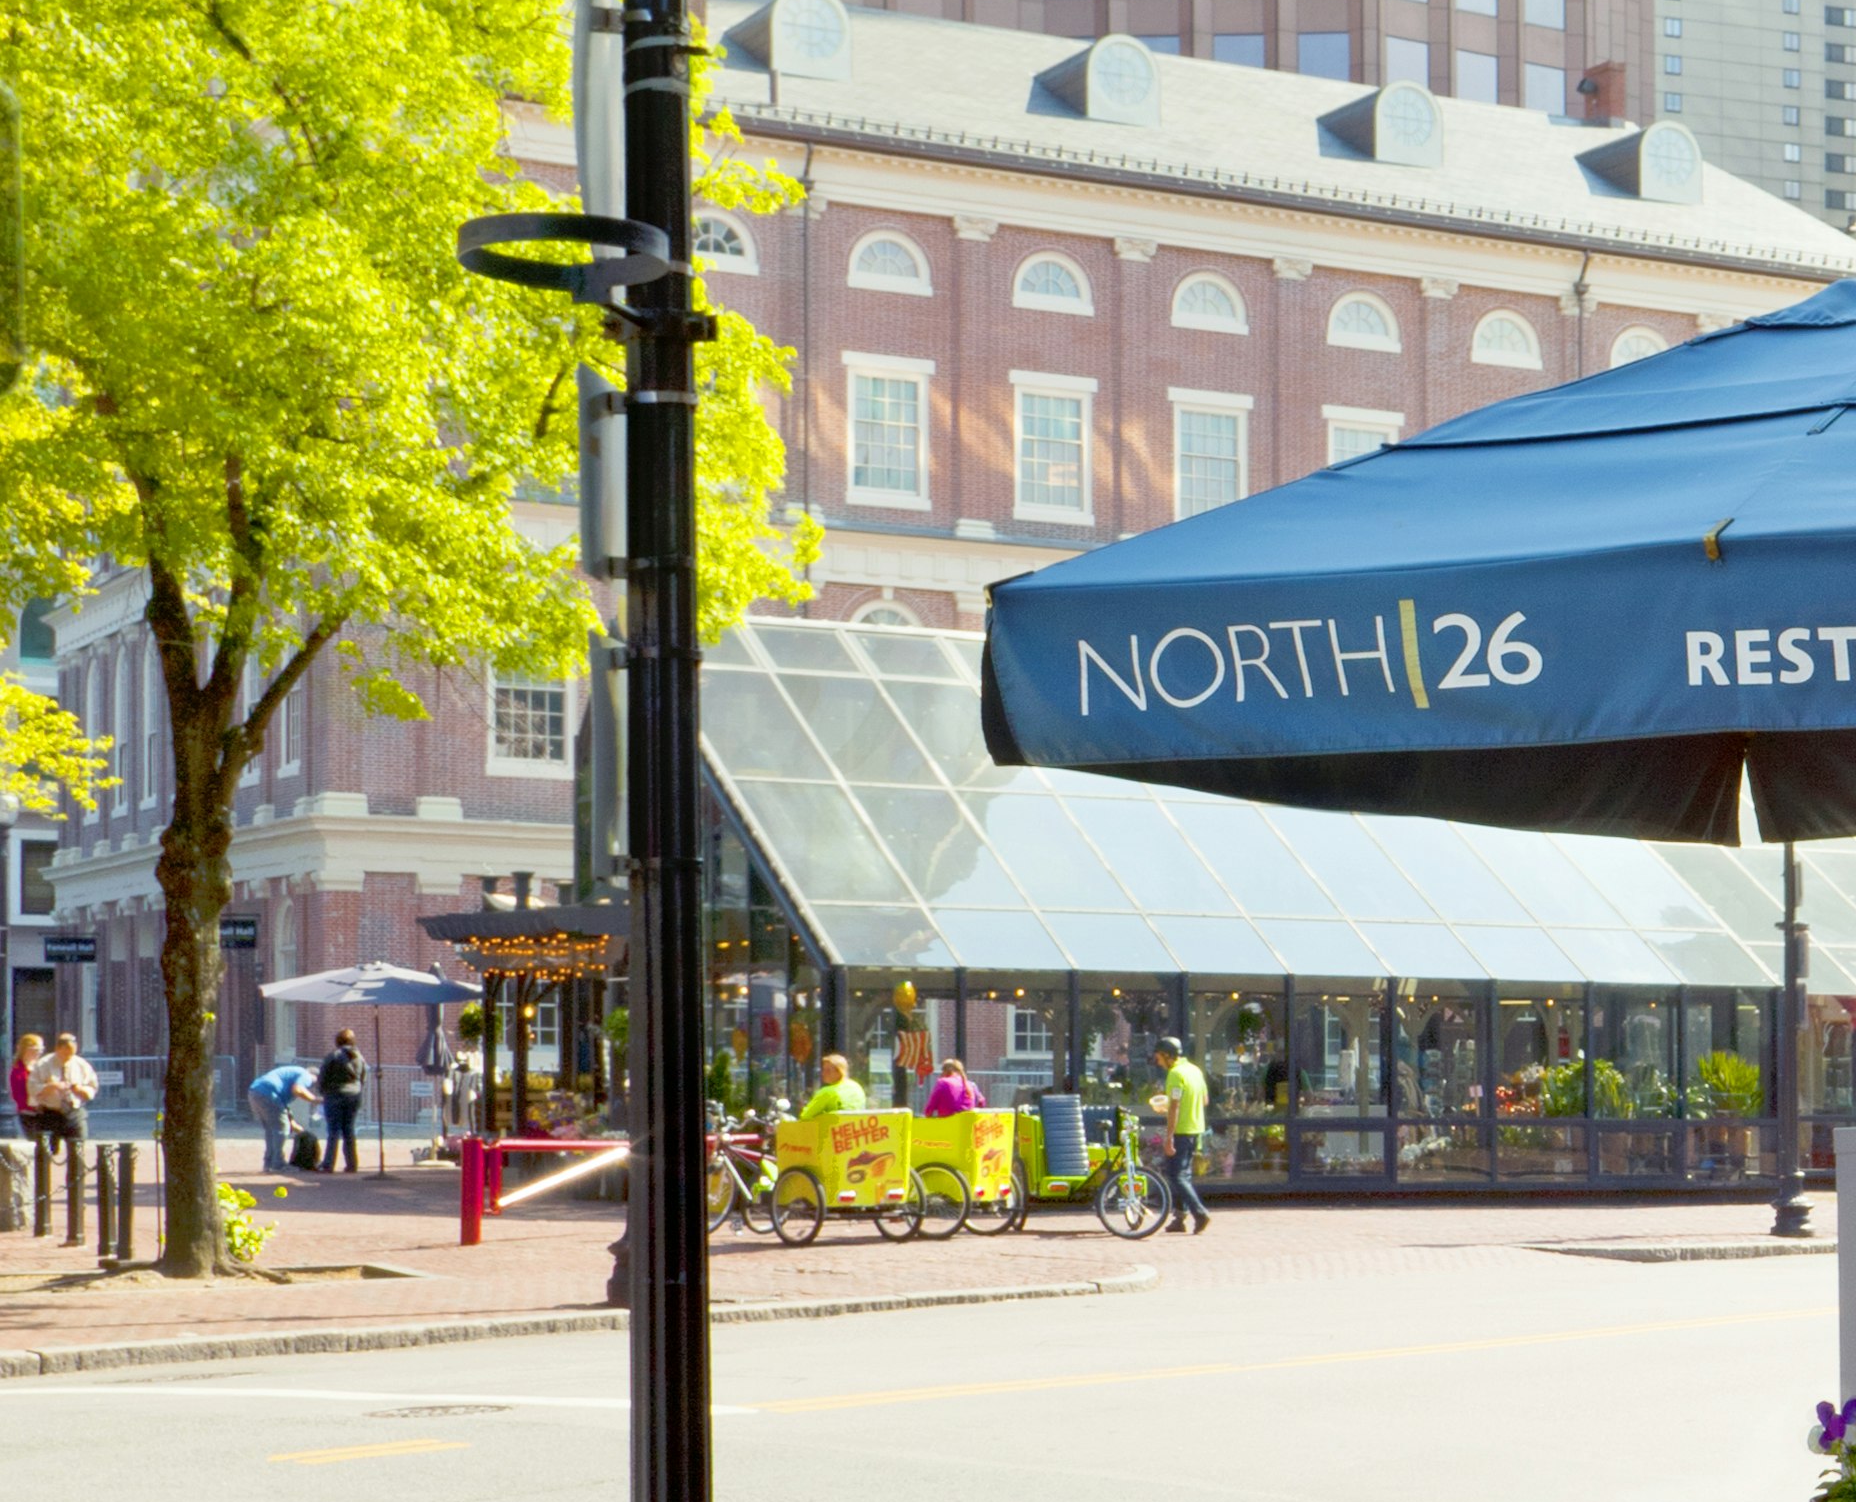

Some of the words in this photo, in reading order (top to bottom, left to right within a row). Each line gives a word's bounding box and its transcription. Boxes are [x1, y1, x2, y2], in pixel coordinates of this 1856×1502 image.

[1079, 614, 1397, 716] NORTH
[1433, 611, 1543, 690] 26
[831, 1115, 879, 1141] HELLO
[833, 1125, 890, 1155] BETTER
